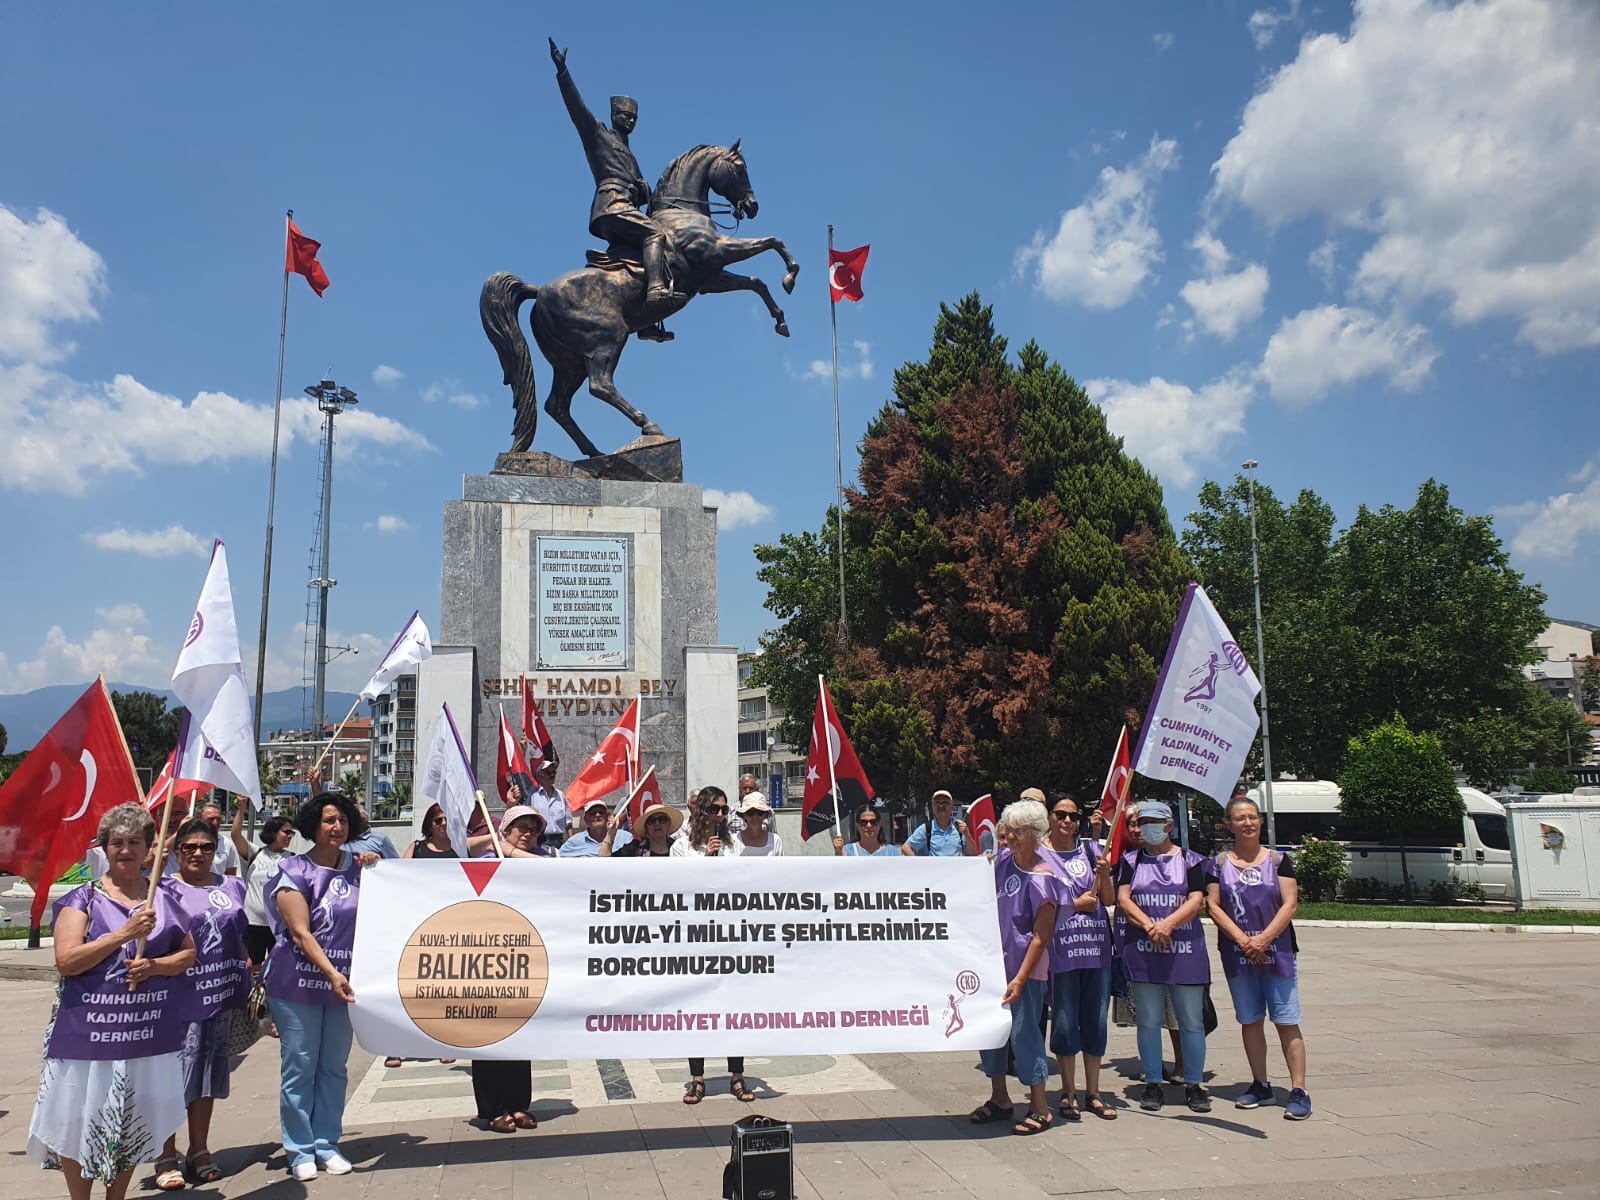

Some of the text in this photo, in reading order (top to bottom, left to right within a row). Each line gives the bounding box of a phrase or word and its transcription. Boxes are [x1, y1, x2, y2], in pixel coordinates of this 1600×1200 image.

[639, 678, 677, 696] BEY
[1160, 717, 1233, 752] CUMHURİYET
[1160, 736, 1220, 765] KADINLARI
[1159, 755, 1209, 778] DERNEĞİ
[589, 888, 947, 913] İSTİKLAL MADALYASI, BALIKESİR
[419, 931, 531, 948] KUVA-Yİ MİLLİYE ŞEHRİ
[588, 918, 949, 948] KUVA-Yİ MİLLİYE ŞEHİTLERİMİZE
[1060, 933, 1105, 945] KADINLARI
[417, 948, 530, 980] BALIKESİR
[587, 955, 775, 976] BORCUMUZDUR!
[298, 977, 333, 991] DERN
[415, 984, 459, 999] İSTİKLAL
[81, 989, 168, 1005] CUMHURİYET
[86, 1009, 162, 1024] KADINLARI
[445, 1003, 498, 1019] BEKLİYOR!
[585, 1005, 930, 1032] CUMHURİYET KADINLARI DERNEĞİ
[89, 1025, 154, 1043] DERNEĞİ
